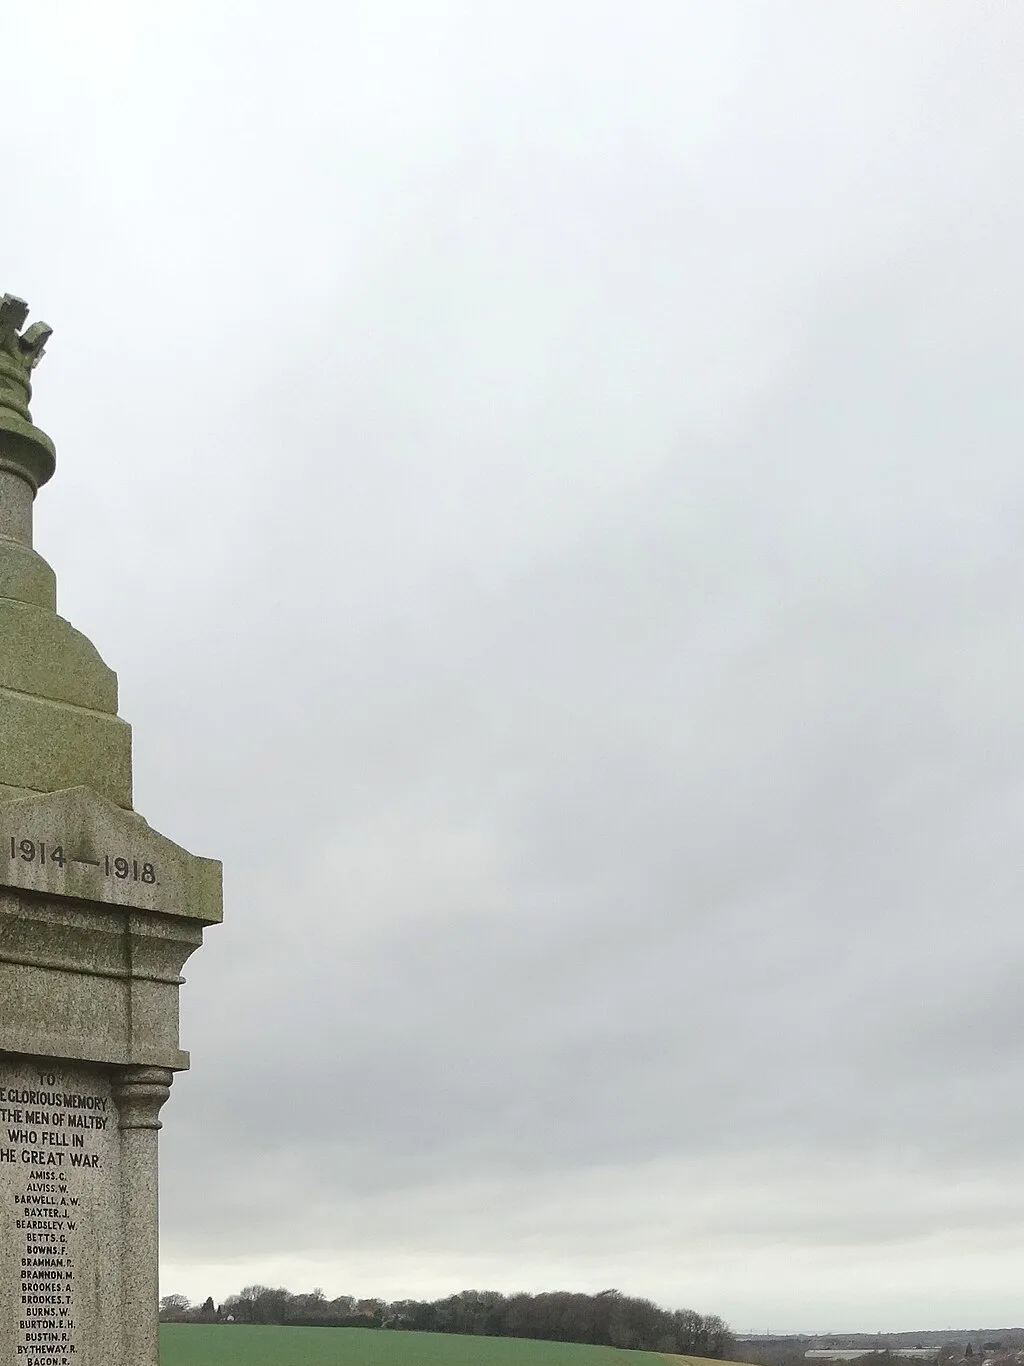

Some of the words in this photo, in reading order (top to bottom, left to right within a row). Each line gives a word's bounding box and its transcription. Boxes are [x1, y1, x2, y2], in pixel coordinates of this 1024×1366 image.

[38, 1072, 56, 1086] TO
[8, 1089, 63, 1107] GLORIOUS
[63, 1094, 107, 1111] MEMORY
[0, 1109, 22, 1123] THE
[26, 1111, 49, 1125] MEN
[52, 1113, 65, 1126] OF
[68, 1114, 108, 1130] MALTBY
[7, 1129, 37, 1144] WHO
[42, 1132, 69, 1146] FELL
[72, 1134, 84, 1147] IN
[22, 1150, 64, 1166] GREAT
[70, 1153, 102, 1168] WAR.
